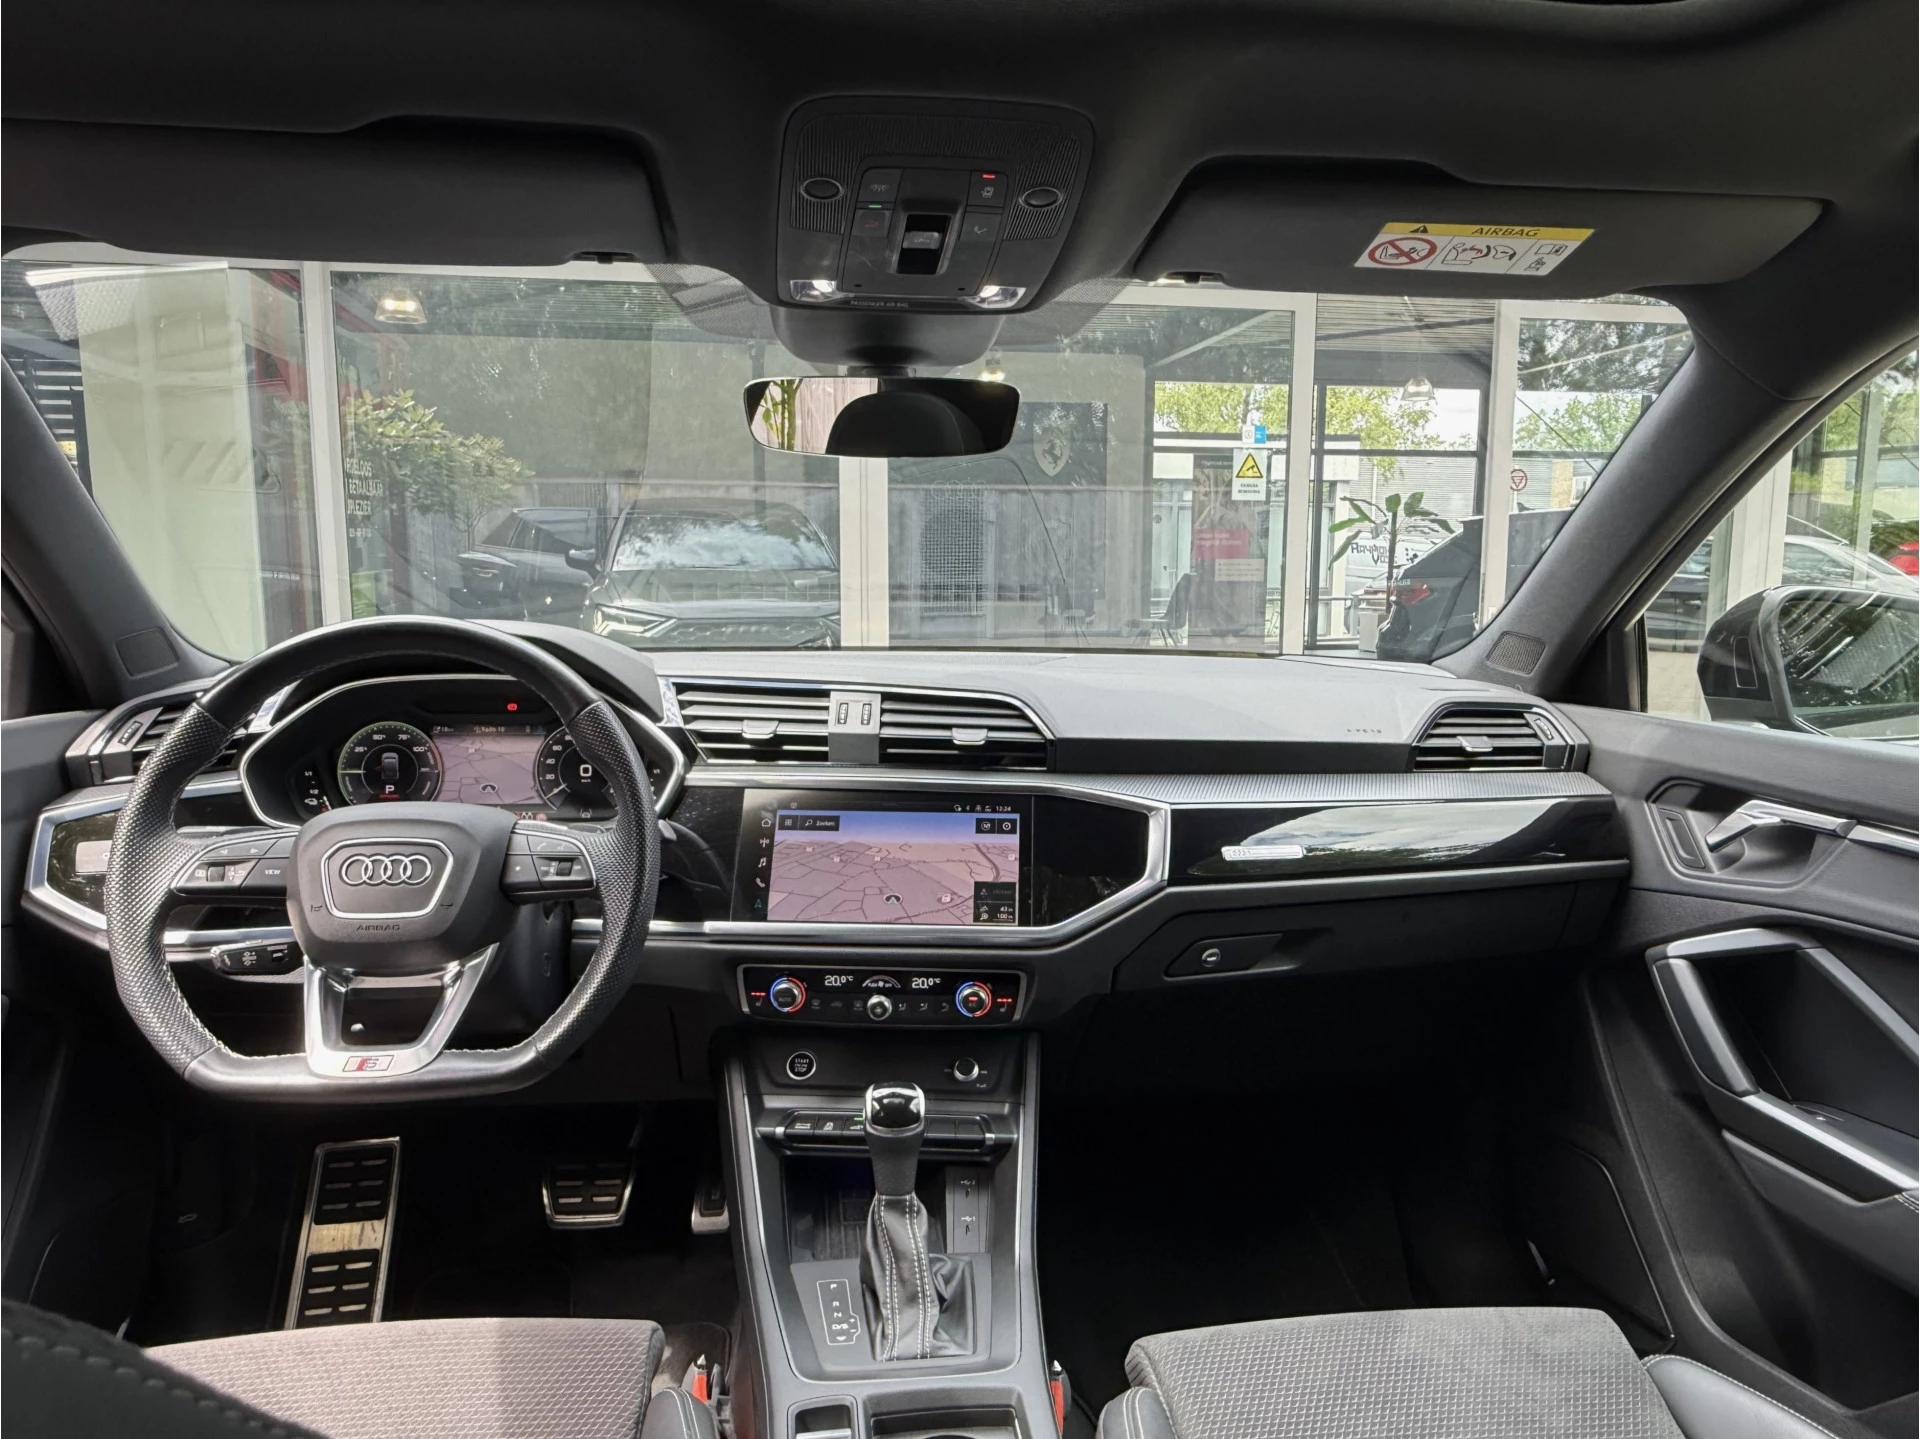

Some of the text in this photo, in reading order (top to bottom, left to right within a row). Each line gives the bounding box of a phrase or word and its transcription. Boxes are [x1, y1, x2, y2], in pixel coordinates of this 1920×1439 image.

[1471, 227, 1541, 237] AIRBAG
[579, 764, 593, 777] 0
[385, 785, 395, 794] P
[357, 924, 401, 932] AIRBAG
